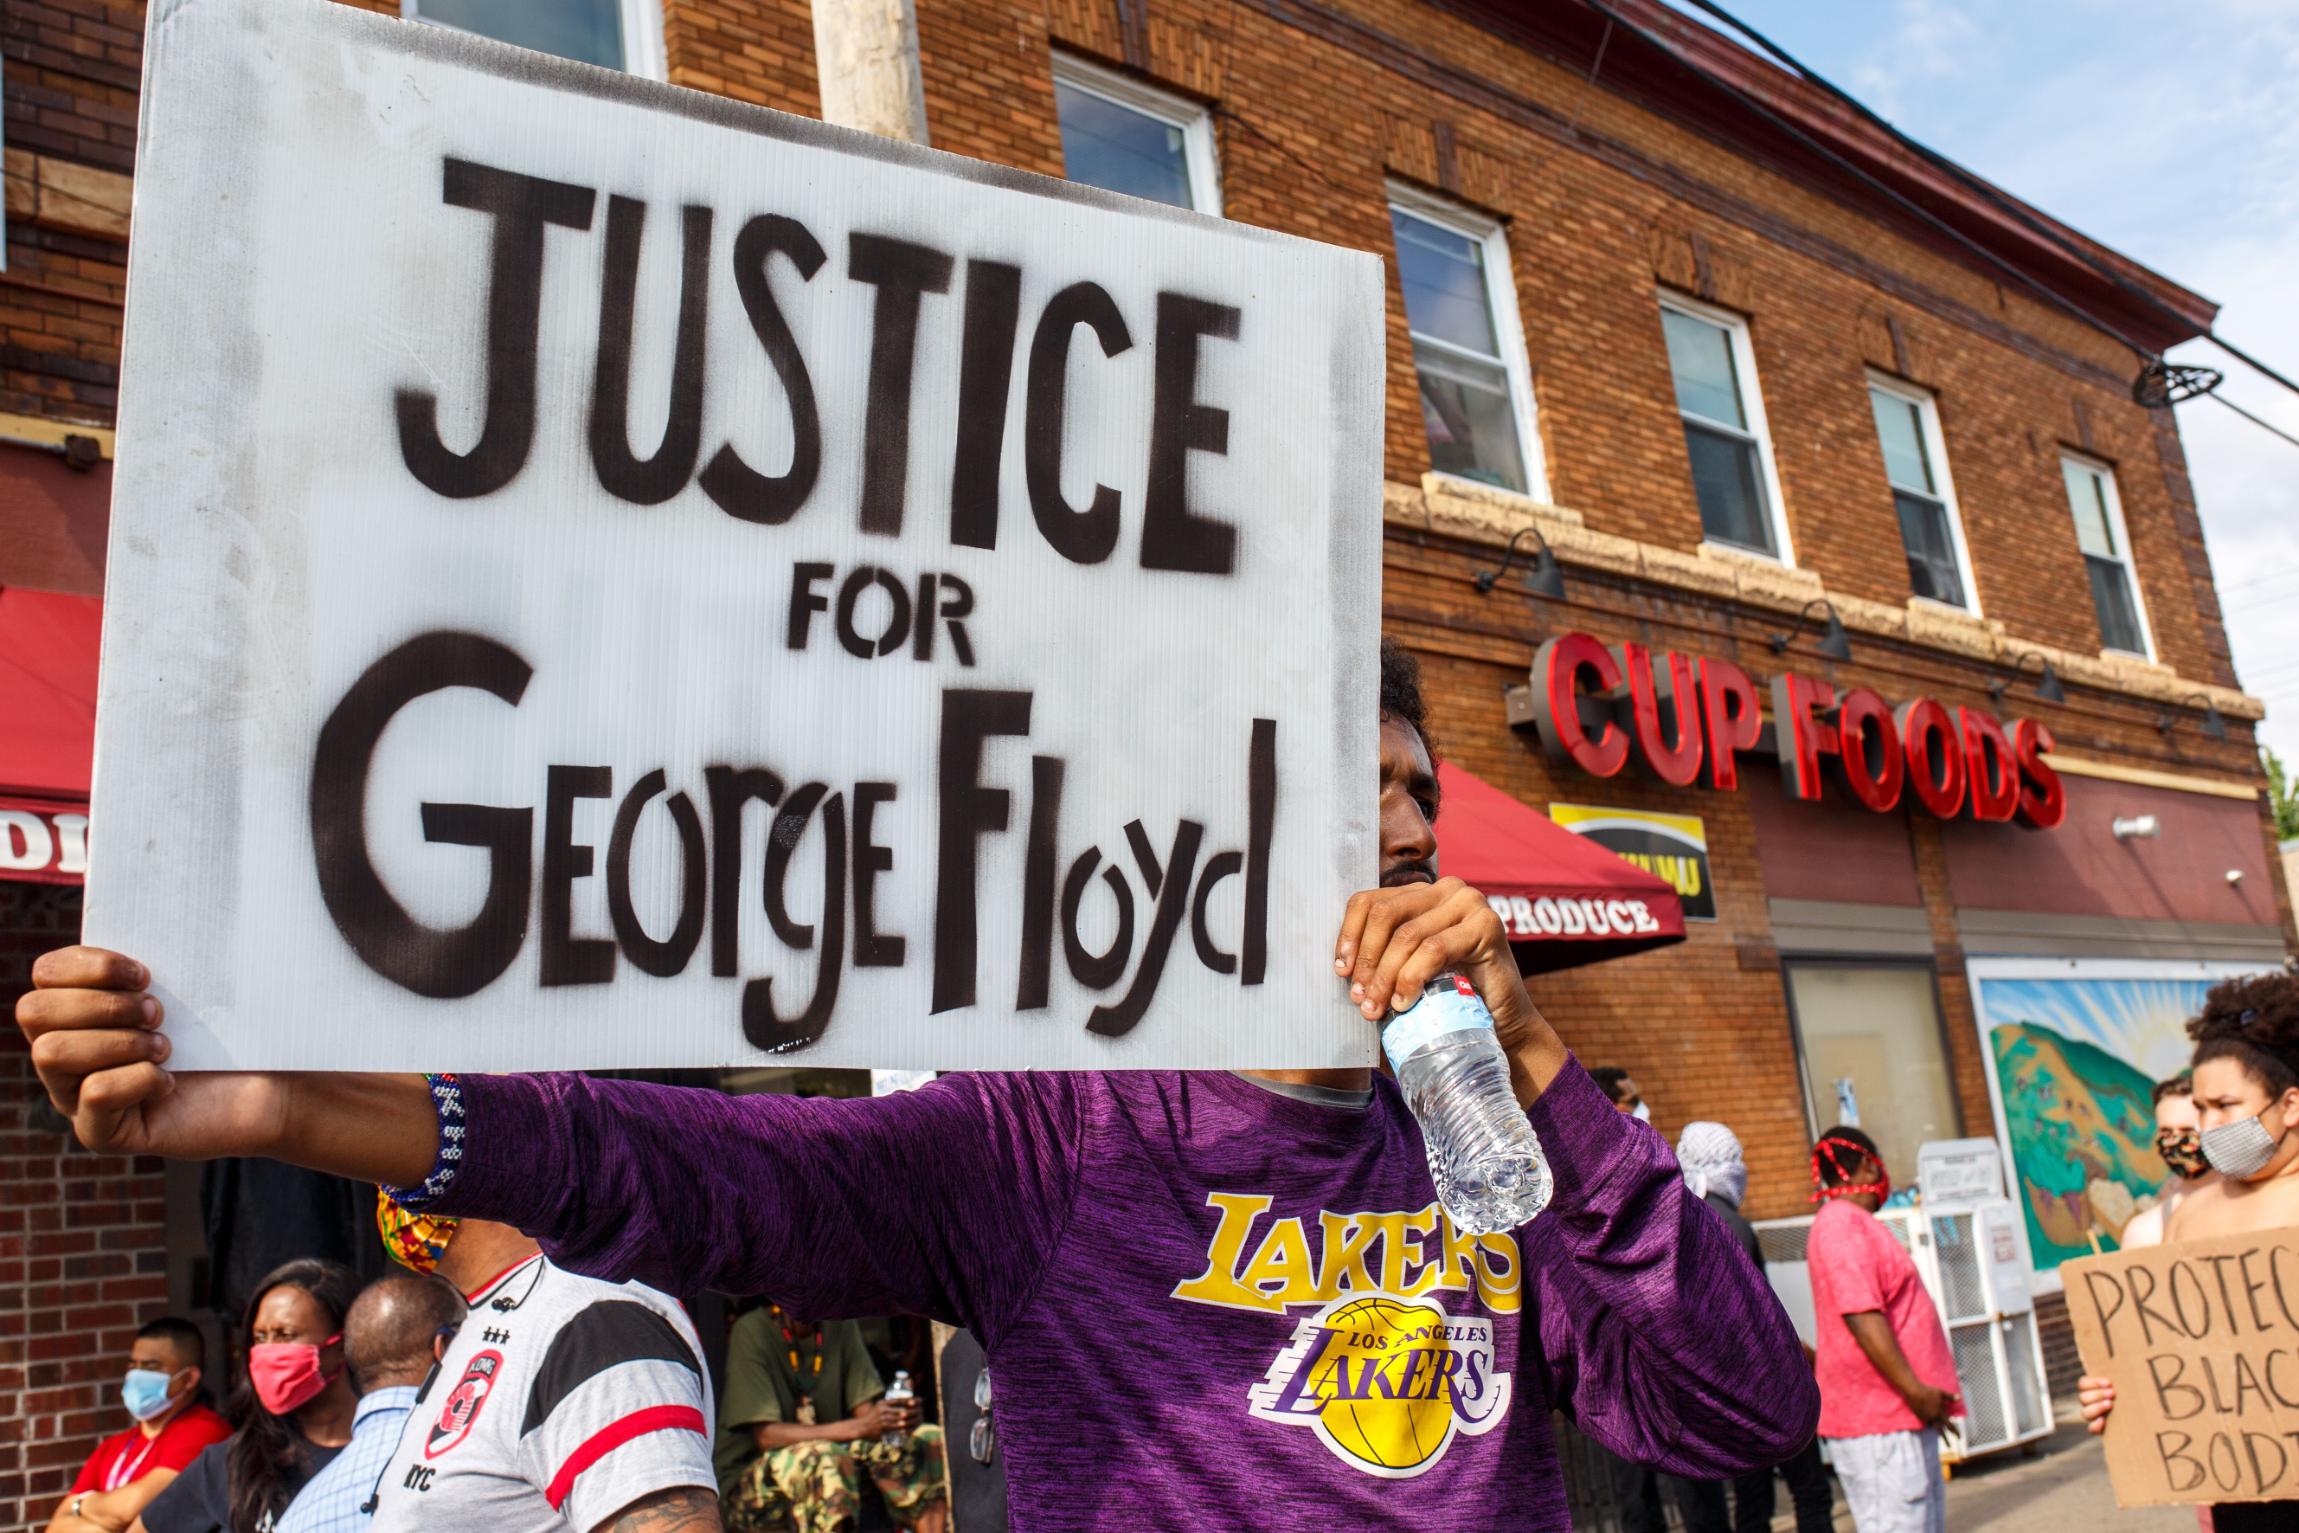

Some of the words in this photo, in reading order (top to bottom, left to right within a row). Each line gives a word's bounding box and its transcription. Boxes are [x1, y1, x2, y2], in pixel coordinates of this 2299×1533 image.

[395, 154, 1242, 577] JUSTICE
[786, 562, 978, 667] FOR
[1532, 631, 1762, 791] CUP
[1772, 672, 2067, 829] FOODS
[1488, 895, 1660, 935] PRODUCE
[1347, 1331, 1389, 1350] LOS
[1394, 1325, 1488, 1347] ANGELES
[2083, 1245, 2299, 1359] PROTEC
[1260, 1326, 1501, 1424] LAKERS
[2147, 1347, 2299, 1420] BLAC
